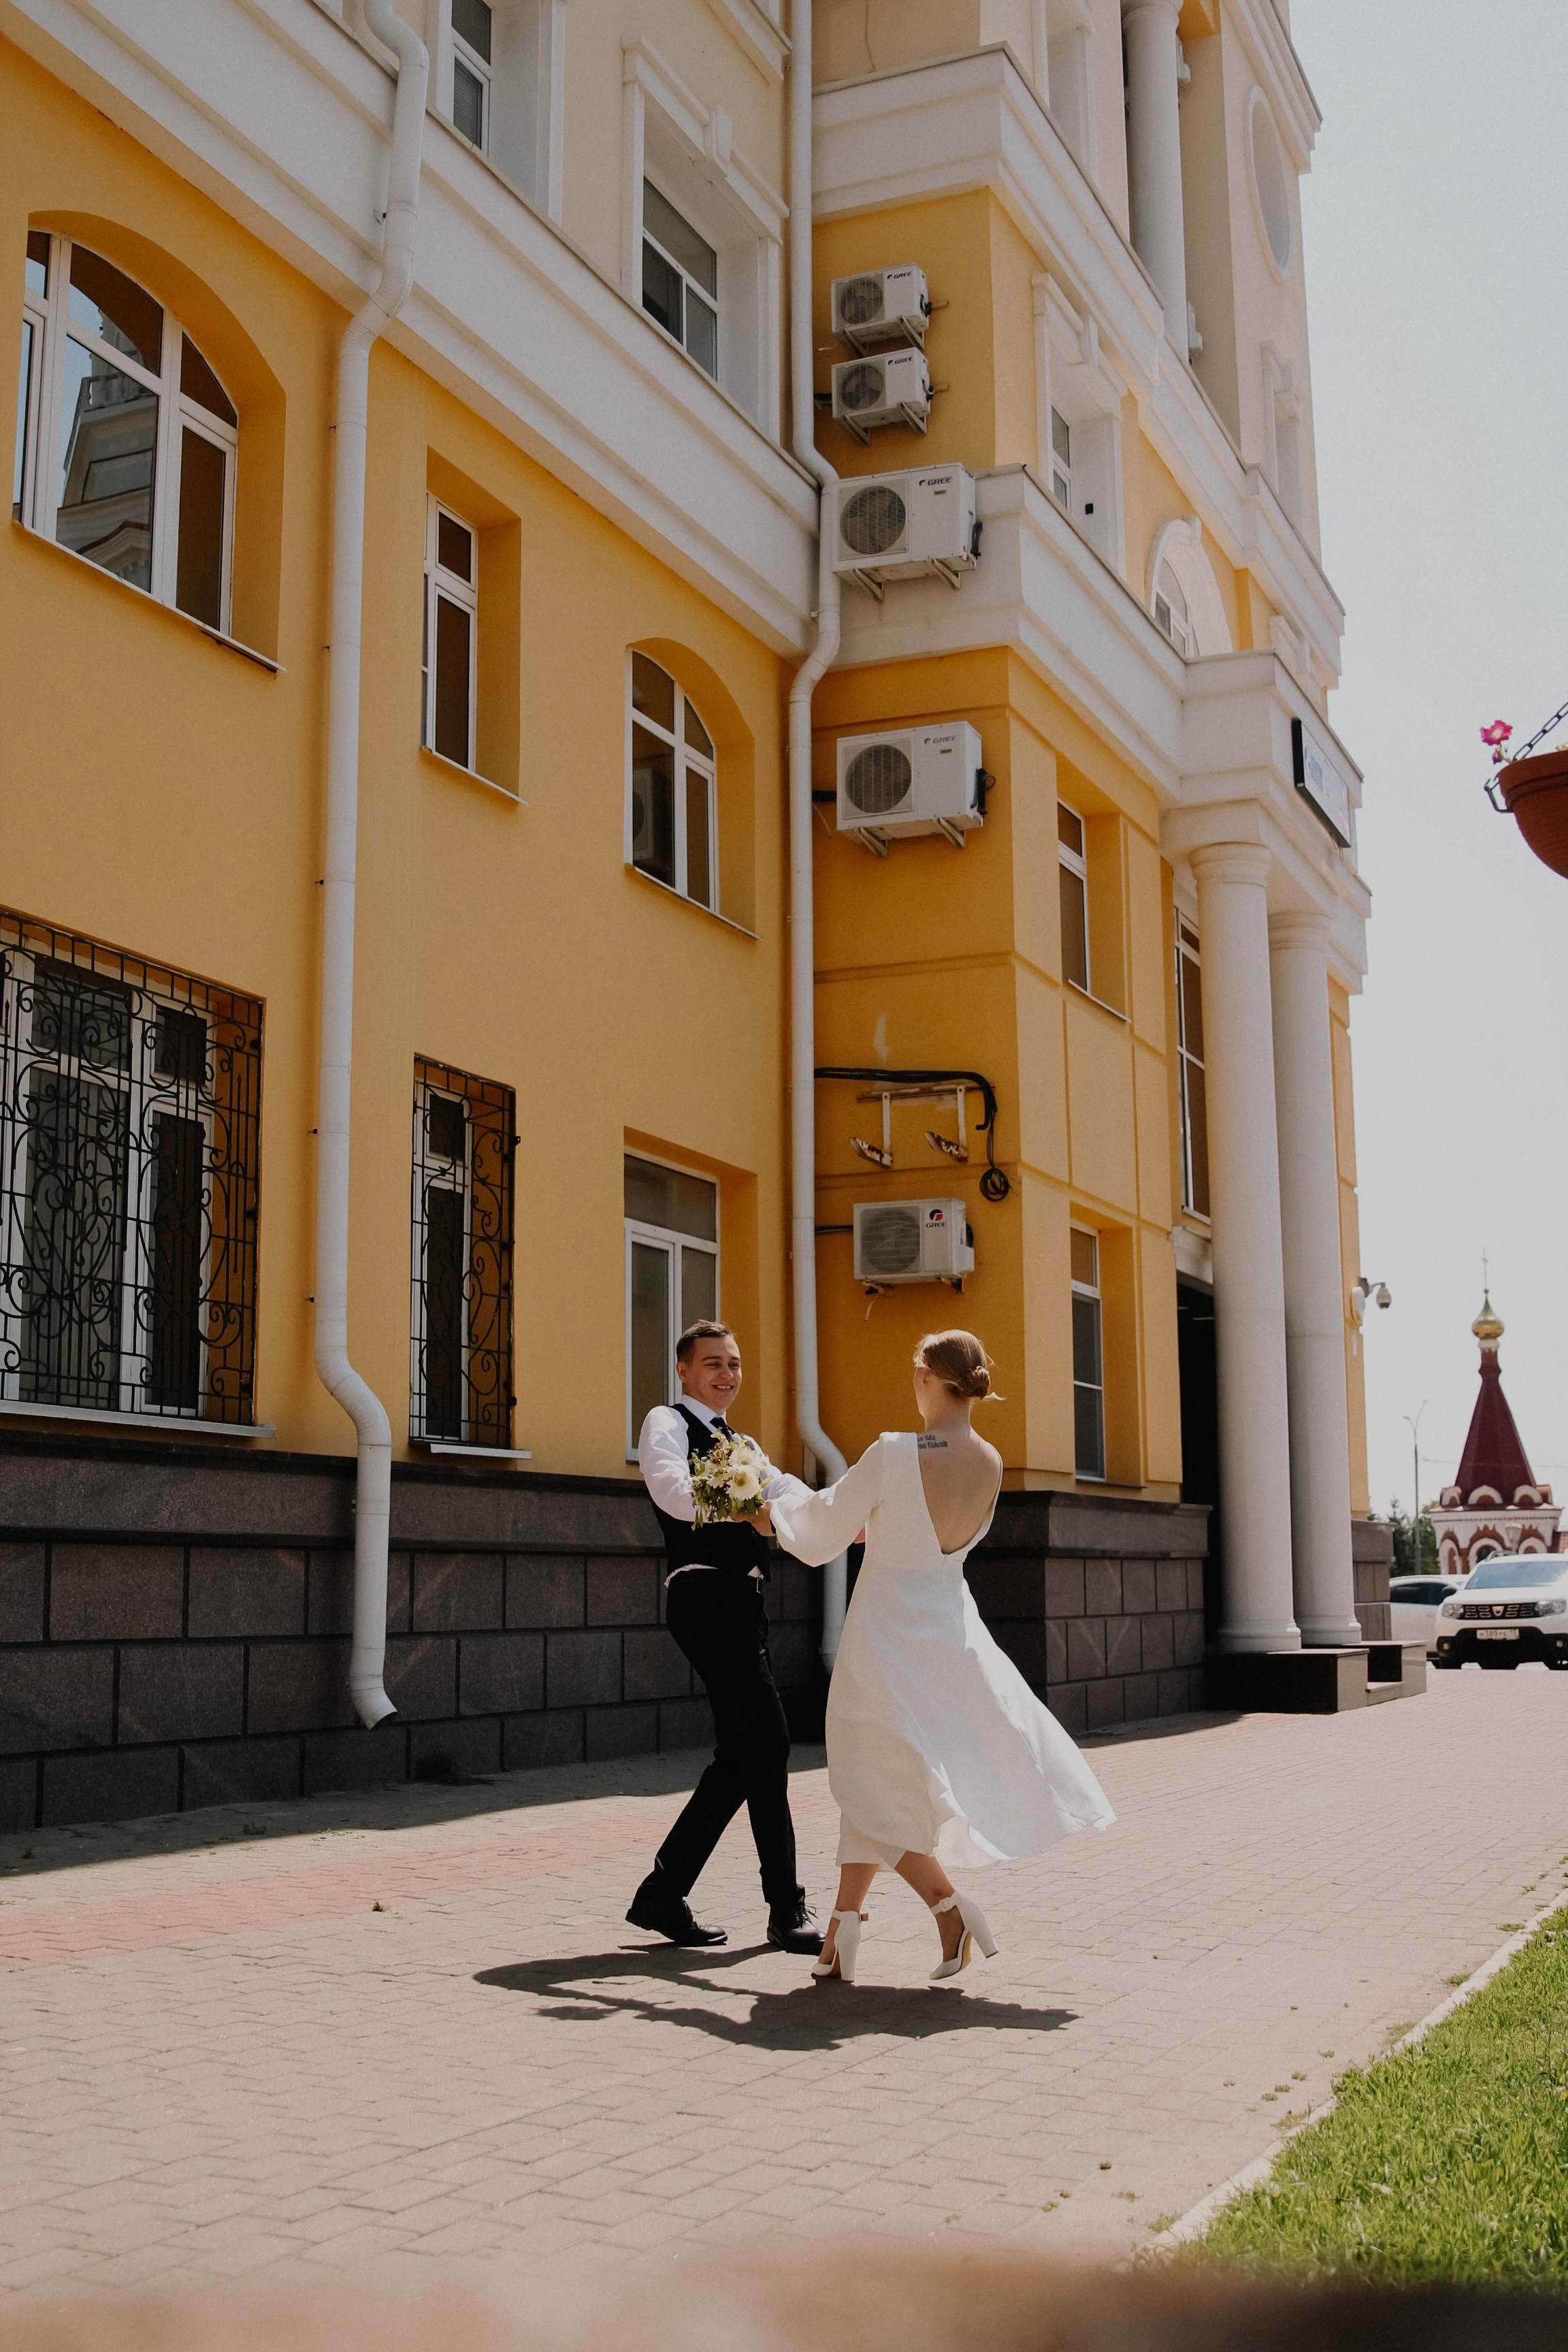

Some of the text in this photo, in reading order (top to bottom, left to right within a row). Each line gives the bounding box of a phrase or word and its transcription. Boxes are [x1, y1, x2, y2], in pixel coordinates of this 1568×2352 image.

[894, 356, 913, 364] GREE
[928, 476, 952, 485] GREE
[933, 735, 957, 743] GREE
